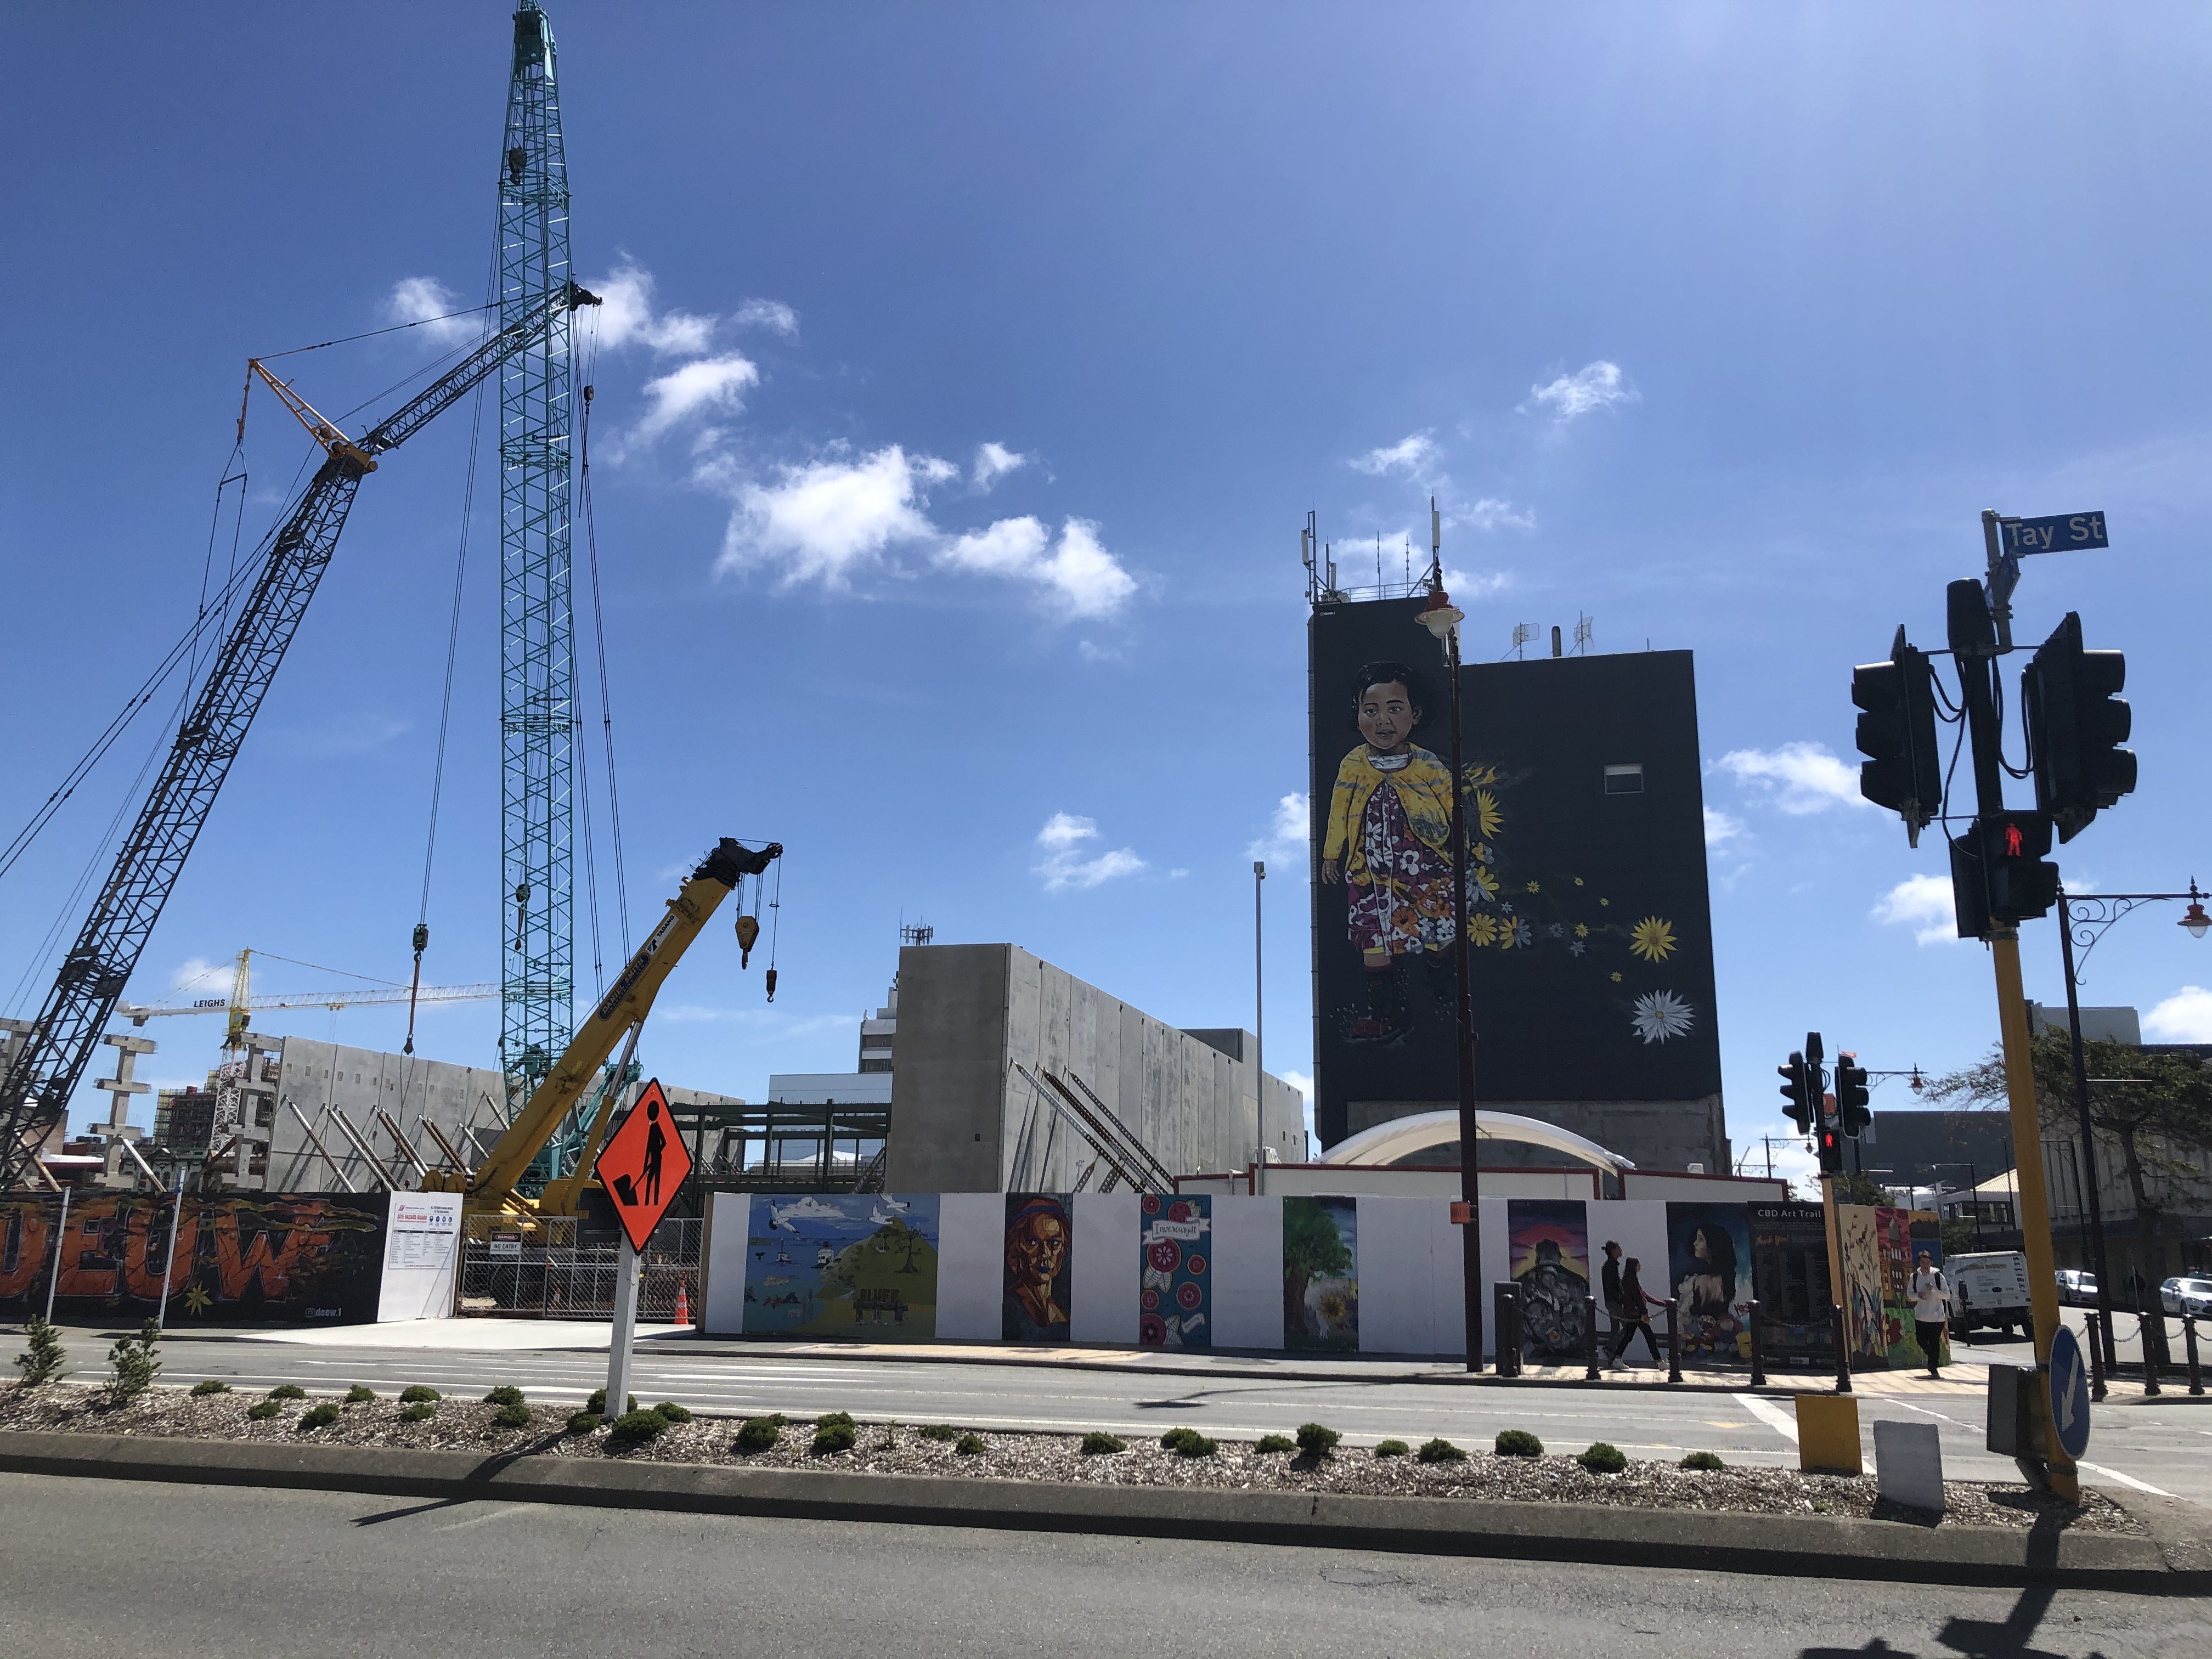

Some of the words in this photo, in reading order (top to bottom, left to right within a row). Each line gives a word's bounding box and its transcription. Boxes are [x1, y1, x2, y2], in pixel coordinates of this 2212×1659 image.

[2005, 522, 2054, 549] Tay
[2069, 516, 2103, 541] St
[657, 915, 674, 936] TADANO
[602, 985, 624, 1014] DANIEL
[625, 957, 644, 983] SMITH
[194, 998, 225, 1007] LEIGHS
